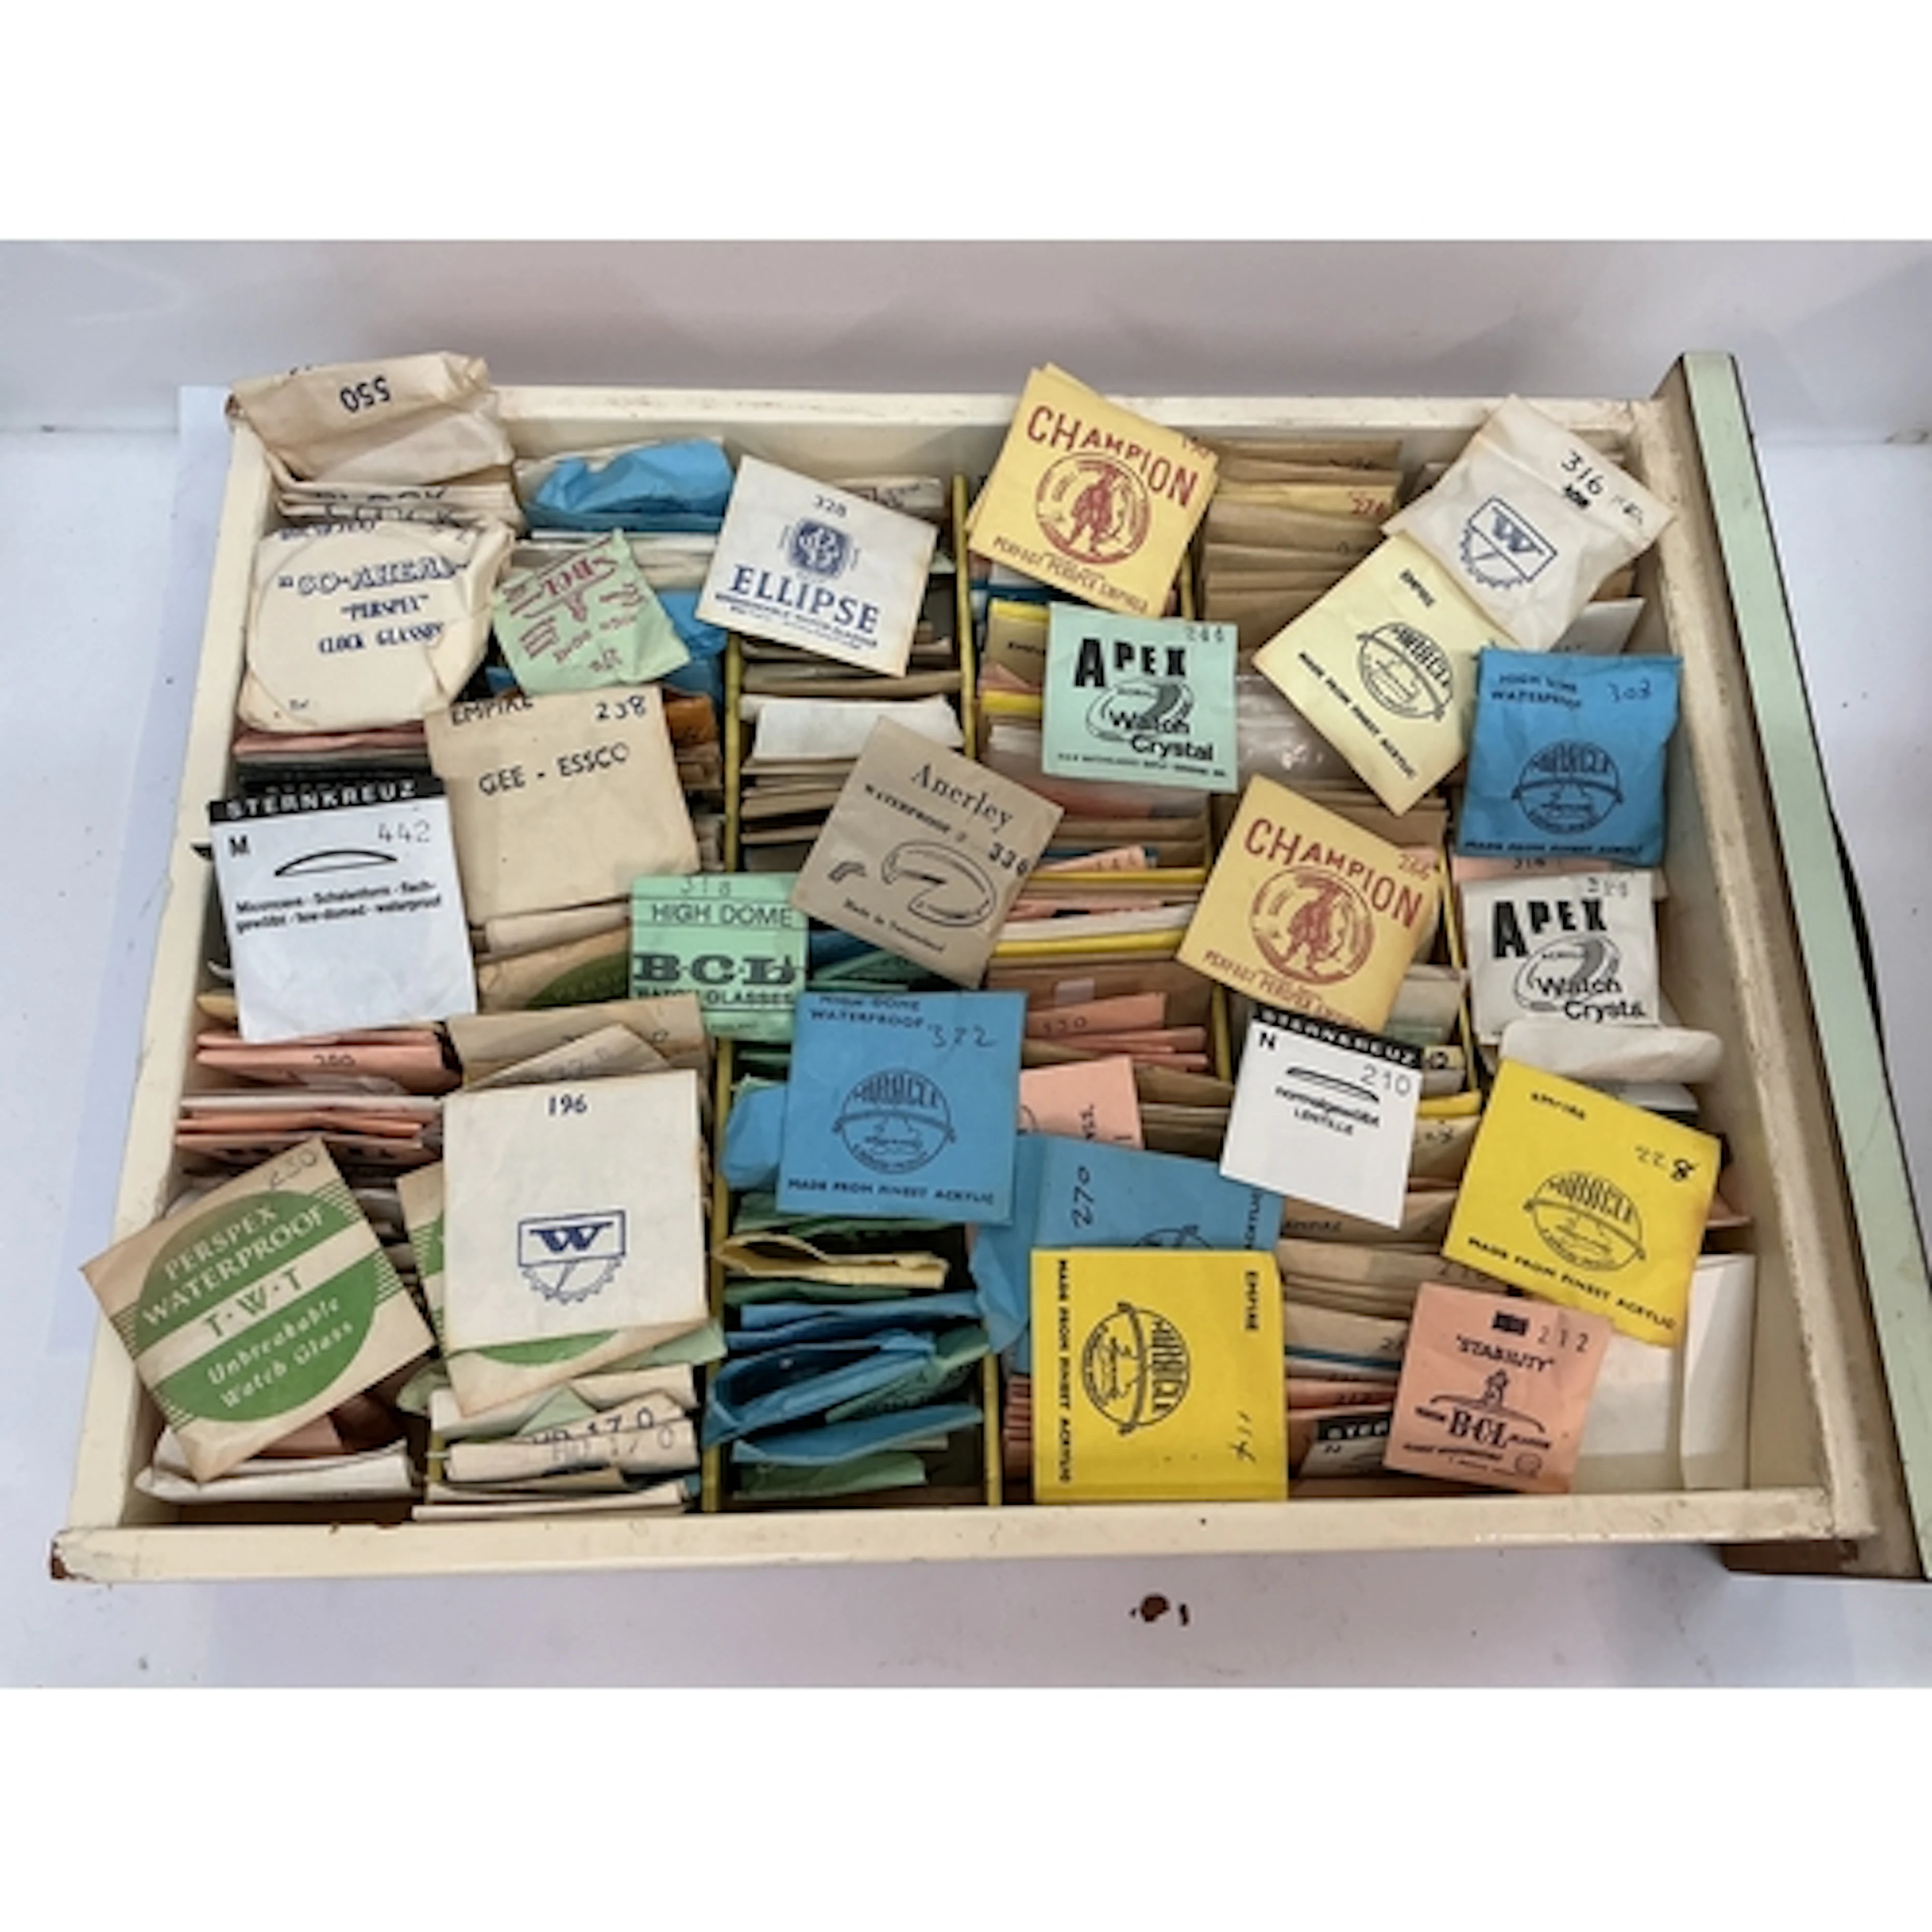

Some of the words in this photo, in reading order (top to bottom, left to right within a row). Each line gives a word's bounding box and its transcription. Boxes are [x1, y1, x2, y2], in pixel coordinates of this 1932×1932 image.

[340, 376, 391, 414] 550
[1027, 405, 1198, 510] CHAMPION
[1561, 449, 1605, 496] 316
[1492, 506, 1544, 555] W
[730, 565, 881, 634] ELLIPSE
[318, 633, 365, 654] CLOCK
[1074, 637, 1187, 688] APEX
[478, 766, 526, 795] GEE
[556, 742, 629, 777] ESSCO
[1132, 735, 1214, 761] Crystal
[225, 780, 416, 820] STERNKREUZ
[911, 763, 1014, 834] Anerley
[229, 834, 250, 856] M
[378, 819, 430, 843] 442
[1244, 818, 1423, 929] CHAMPION
[652, 903, 711, 924] HIGH
[719, 905, 794, 927] DOME
[1492, 898, 1607, 958] APEX
[810, 1009, 924, 1028] WATERPROOF
[1259, 1031, 1275, 1050] N
[1361, 1063, 1410, 1097] 210
[548, 1093, 588, 1115] 196
[1071, 1165, 1094, 1229] 270
[163, 1204, 278, 1281] PERSPEX
[529, 1221, 614, 1252] W
[143, 1205, 327, 1326] WATERPROOF
[1538, 1326, 1589, 1352] 212
[220, 1361, 288, 1408] Watch
[293, 1321, 354, 1365] Glass
